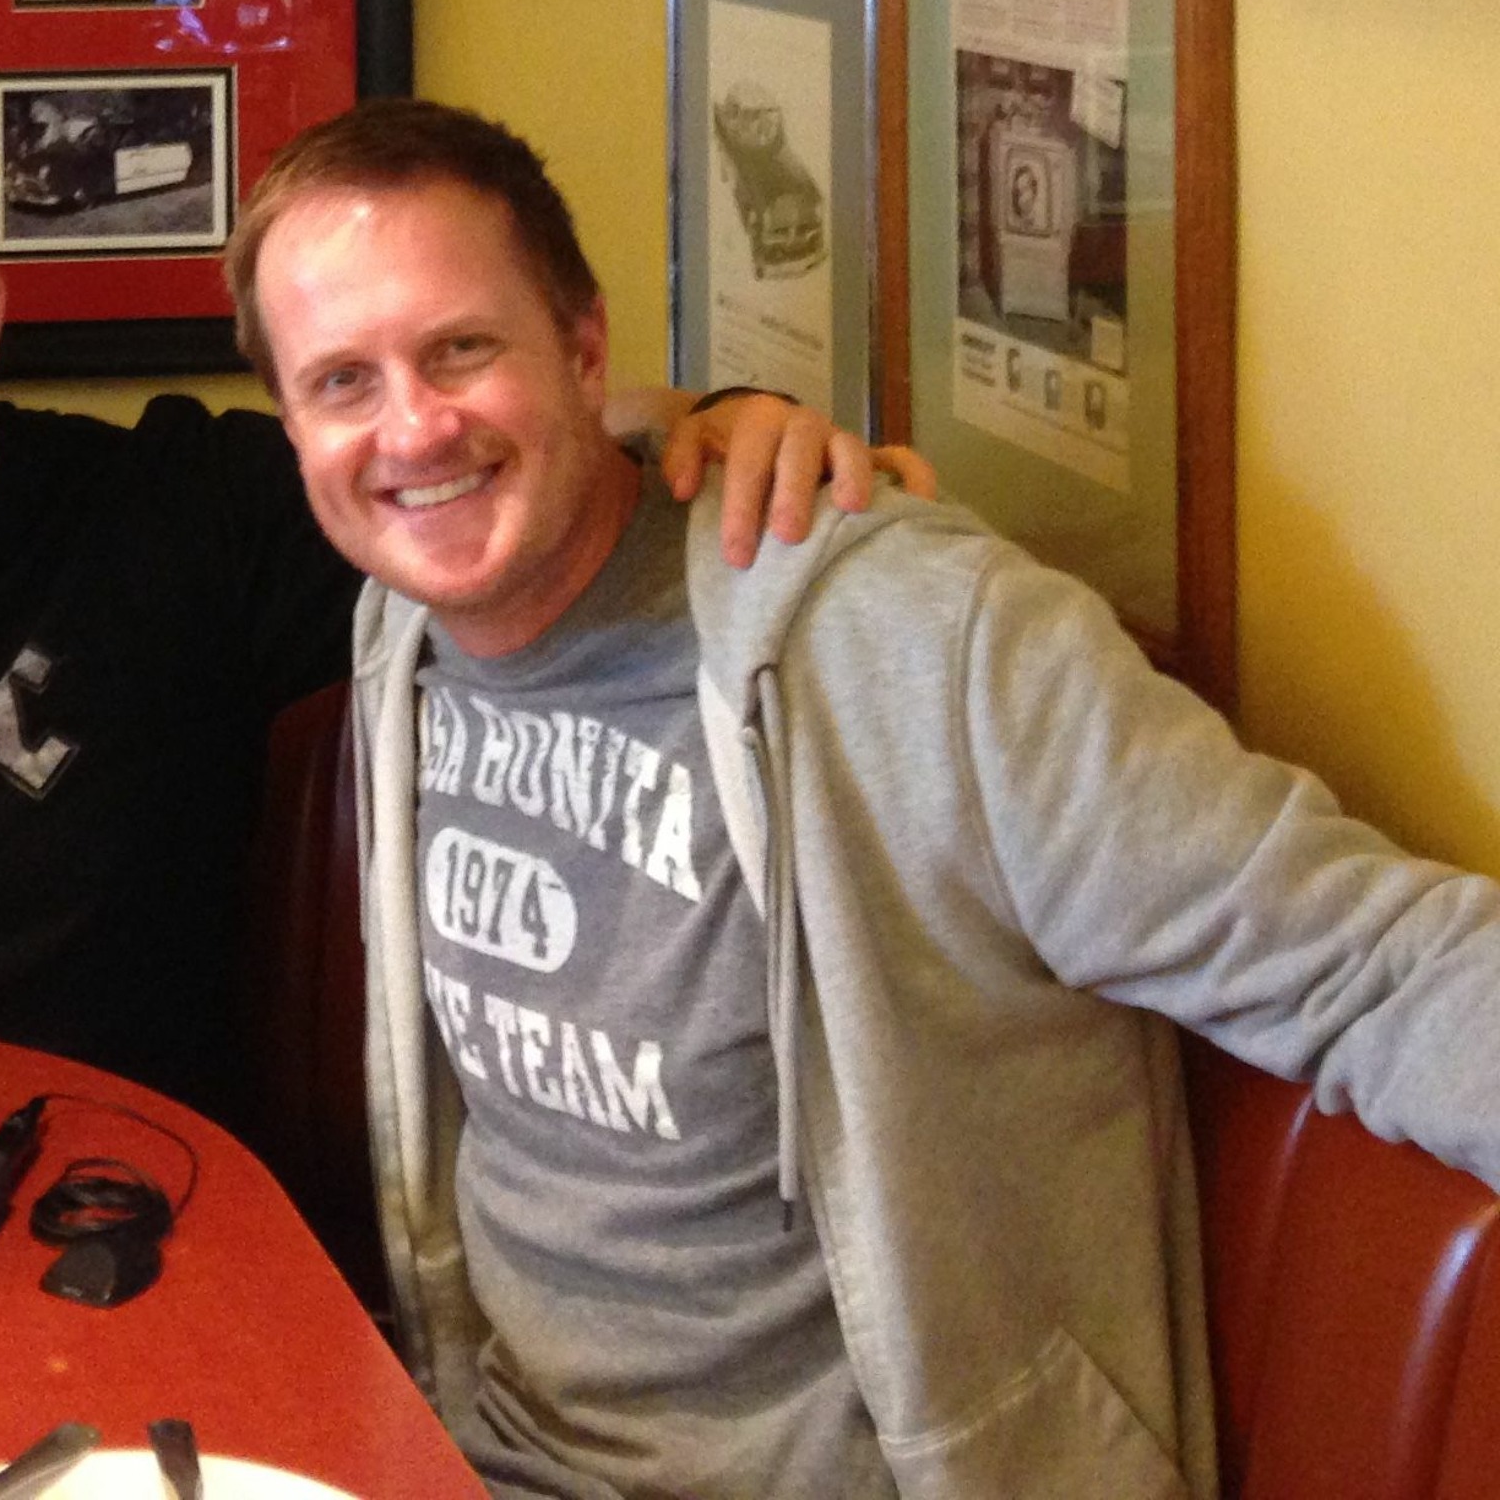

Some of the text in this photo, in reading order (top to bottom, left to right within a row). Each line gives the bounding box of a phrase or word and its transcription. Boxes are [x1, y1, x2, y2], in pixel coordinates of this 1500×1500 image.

[469, 694, 702, 903] BONITA
[444, 841, 550, 959] 1974
[483, 992, 682, 1141] TEAM
